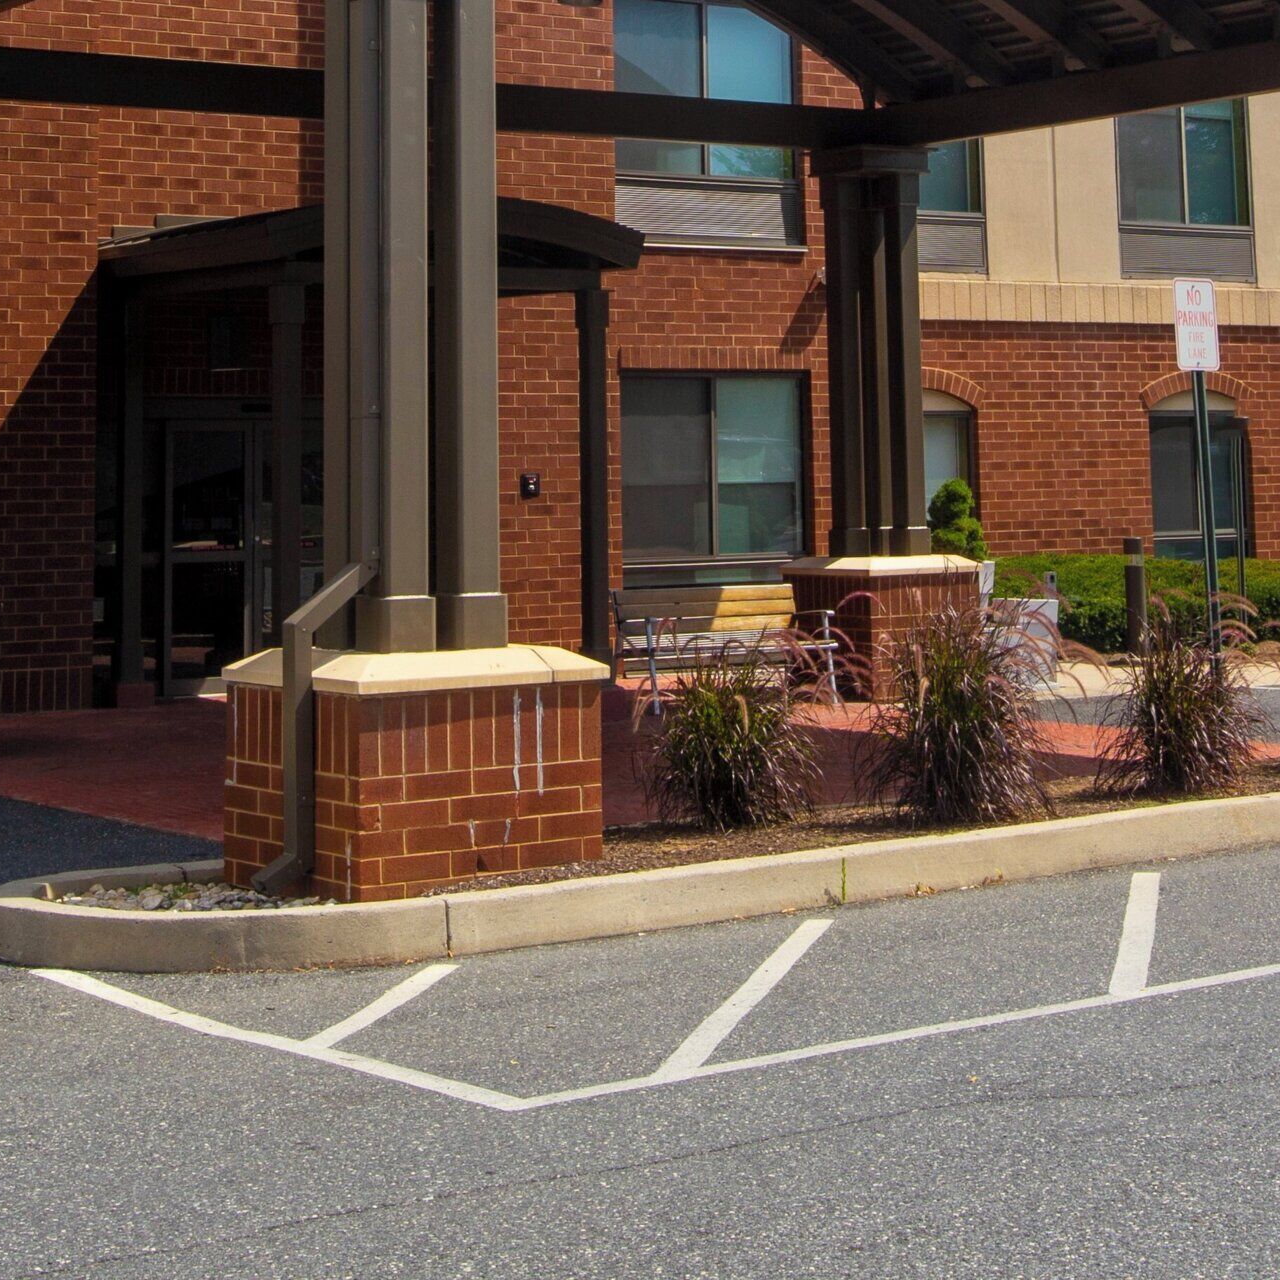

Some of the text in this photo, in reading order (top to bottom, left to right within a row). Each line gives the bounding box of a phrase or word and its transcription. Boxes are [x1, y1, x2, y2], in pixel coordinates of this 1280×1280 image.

[1186, 289, 1202, 306] NO
[1177, 310, 1214, 328] PARKING
[1188, 331, 1205, 344] FIRE
[1187, 347, 1207, 360] LANE
